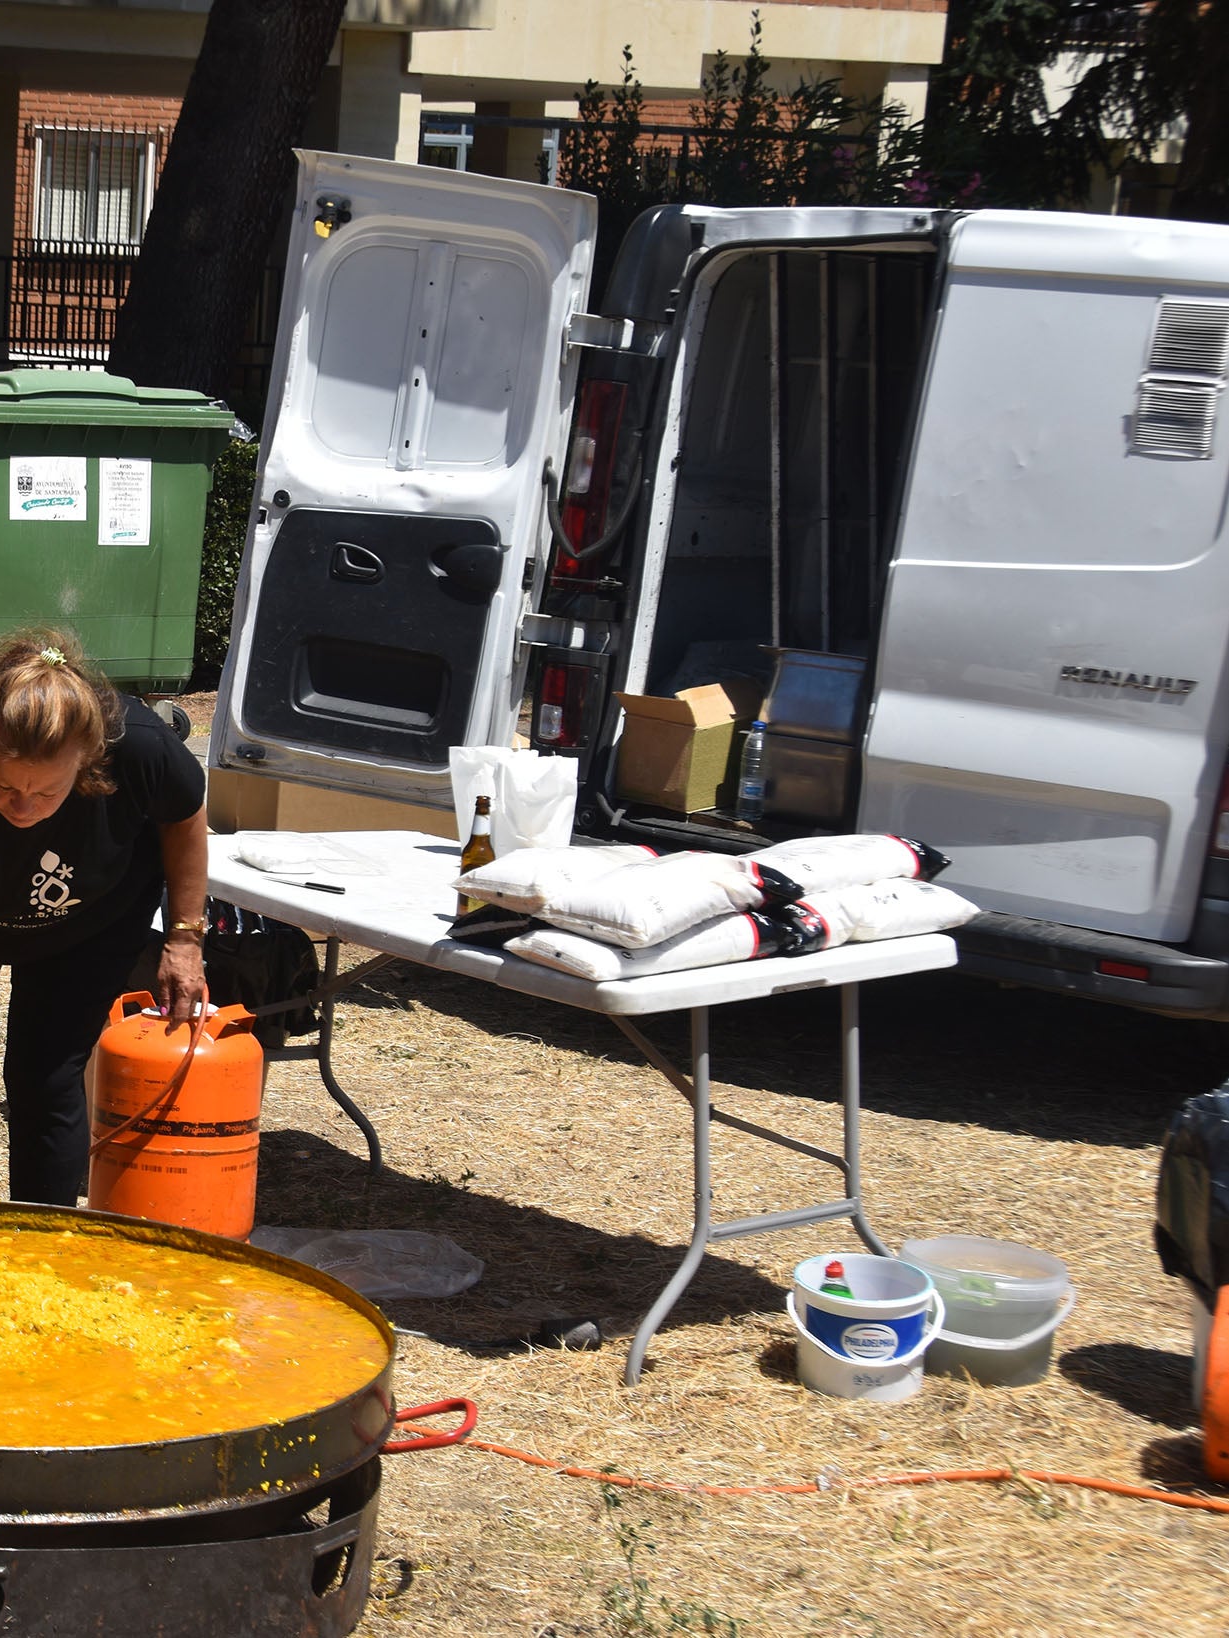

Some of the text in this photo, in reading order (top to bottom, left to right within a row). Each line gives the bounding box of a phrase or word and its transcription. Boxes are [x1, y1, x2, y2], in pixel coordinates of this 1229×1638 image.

[1060, 664, 1200, 695] RENAULT
[182, 1125, 216, 1135] Propano
[844, 1335, 896, 1348] PHILADELPHIA
